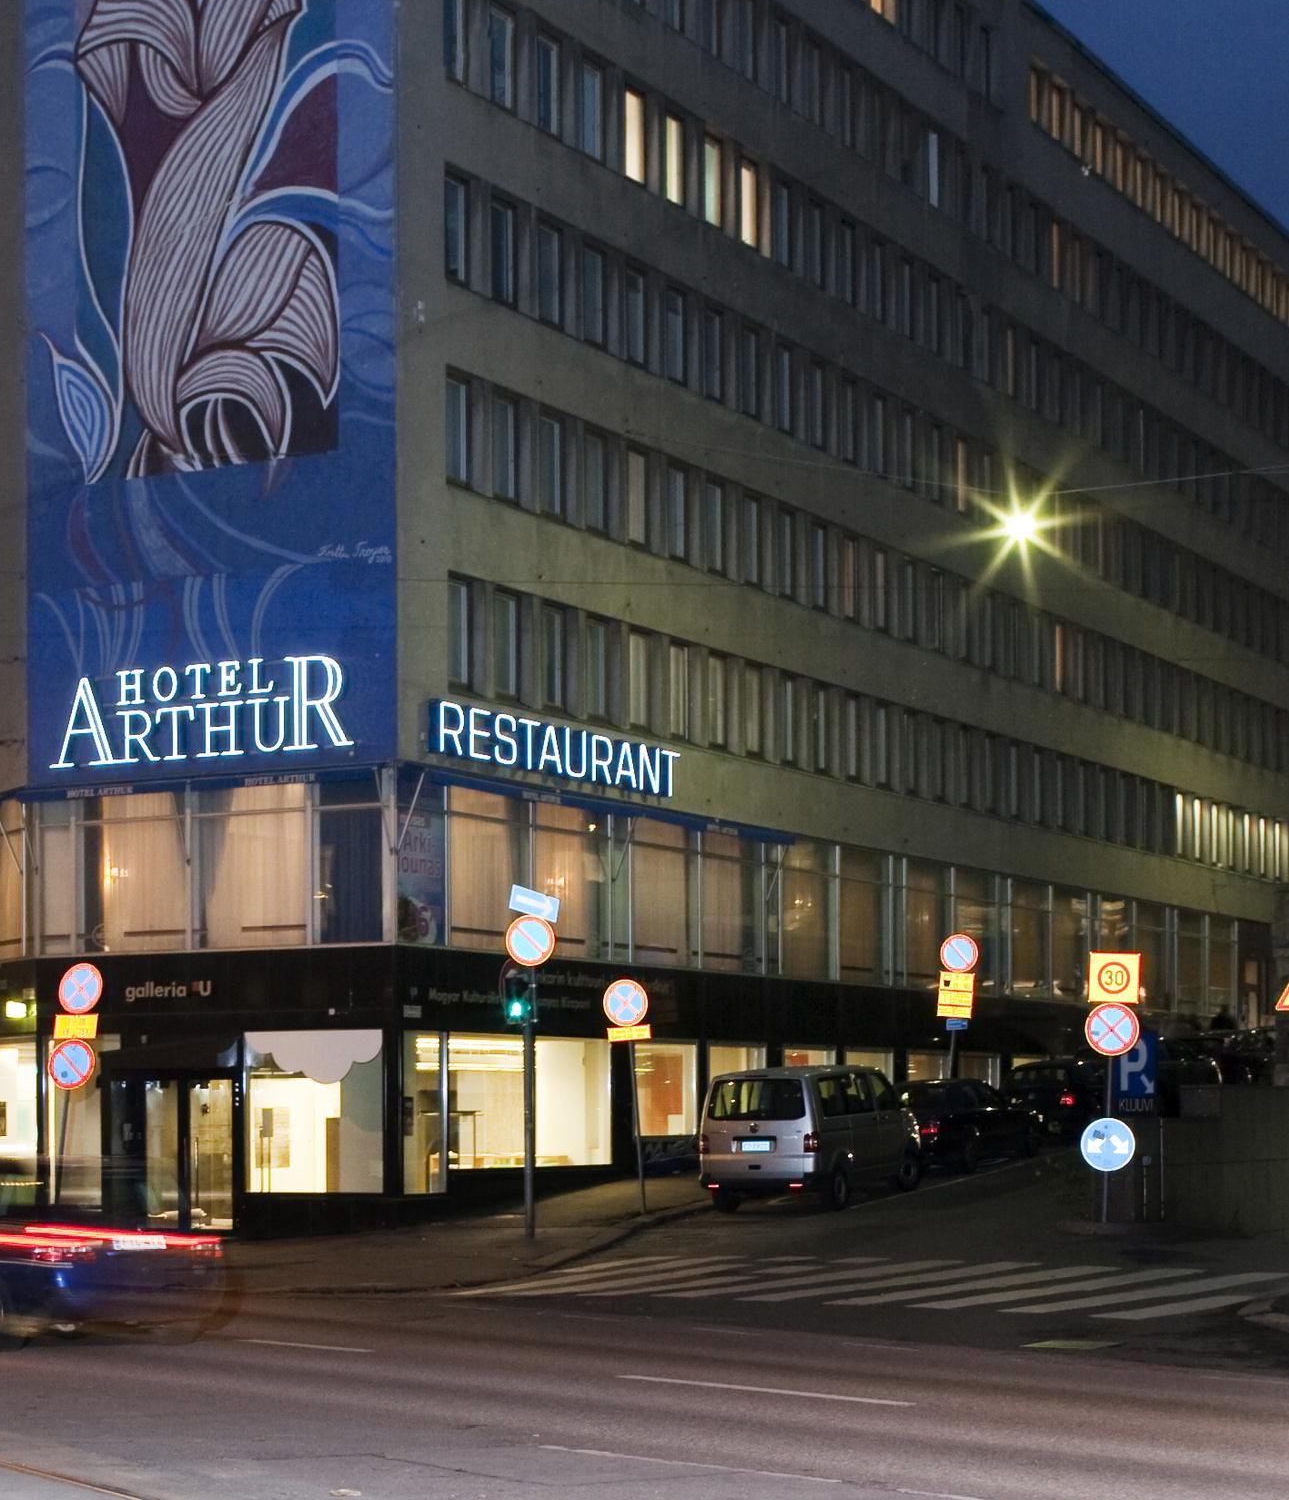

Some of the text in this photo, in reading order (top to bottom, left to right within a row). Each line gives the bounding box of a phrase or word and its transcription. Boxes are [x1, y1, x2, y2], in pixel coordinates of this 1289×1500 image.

[115, 656, 274, 706] HOTEL
[50, 654, 354, 770] ARTHUR
[438, 699, 681, 798] RESTAURANT
[244, 773, 316, 786] HOTEL ARTHUR
[66, 786, 134, 798] HOTEL ARTHUR
[1104, 970, 1124, 986] 30
[125, 981, 187, 1002] galleria
